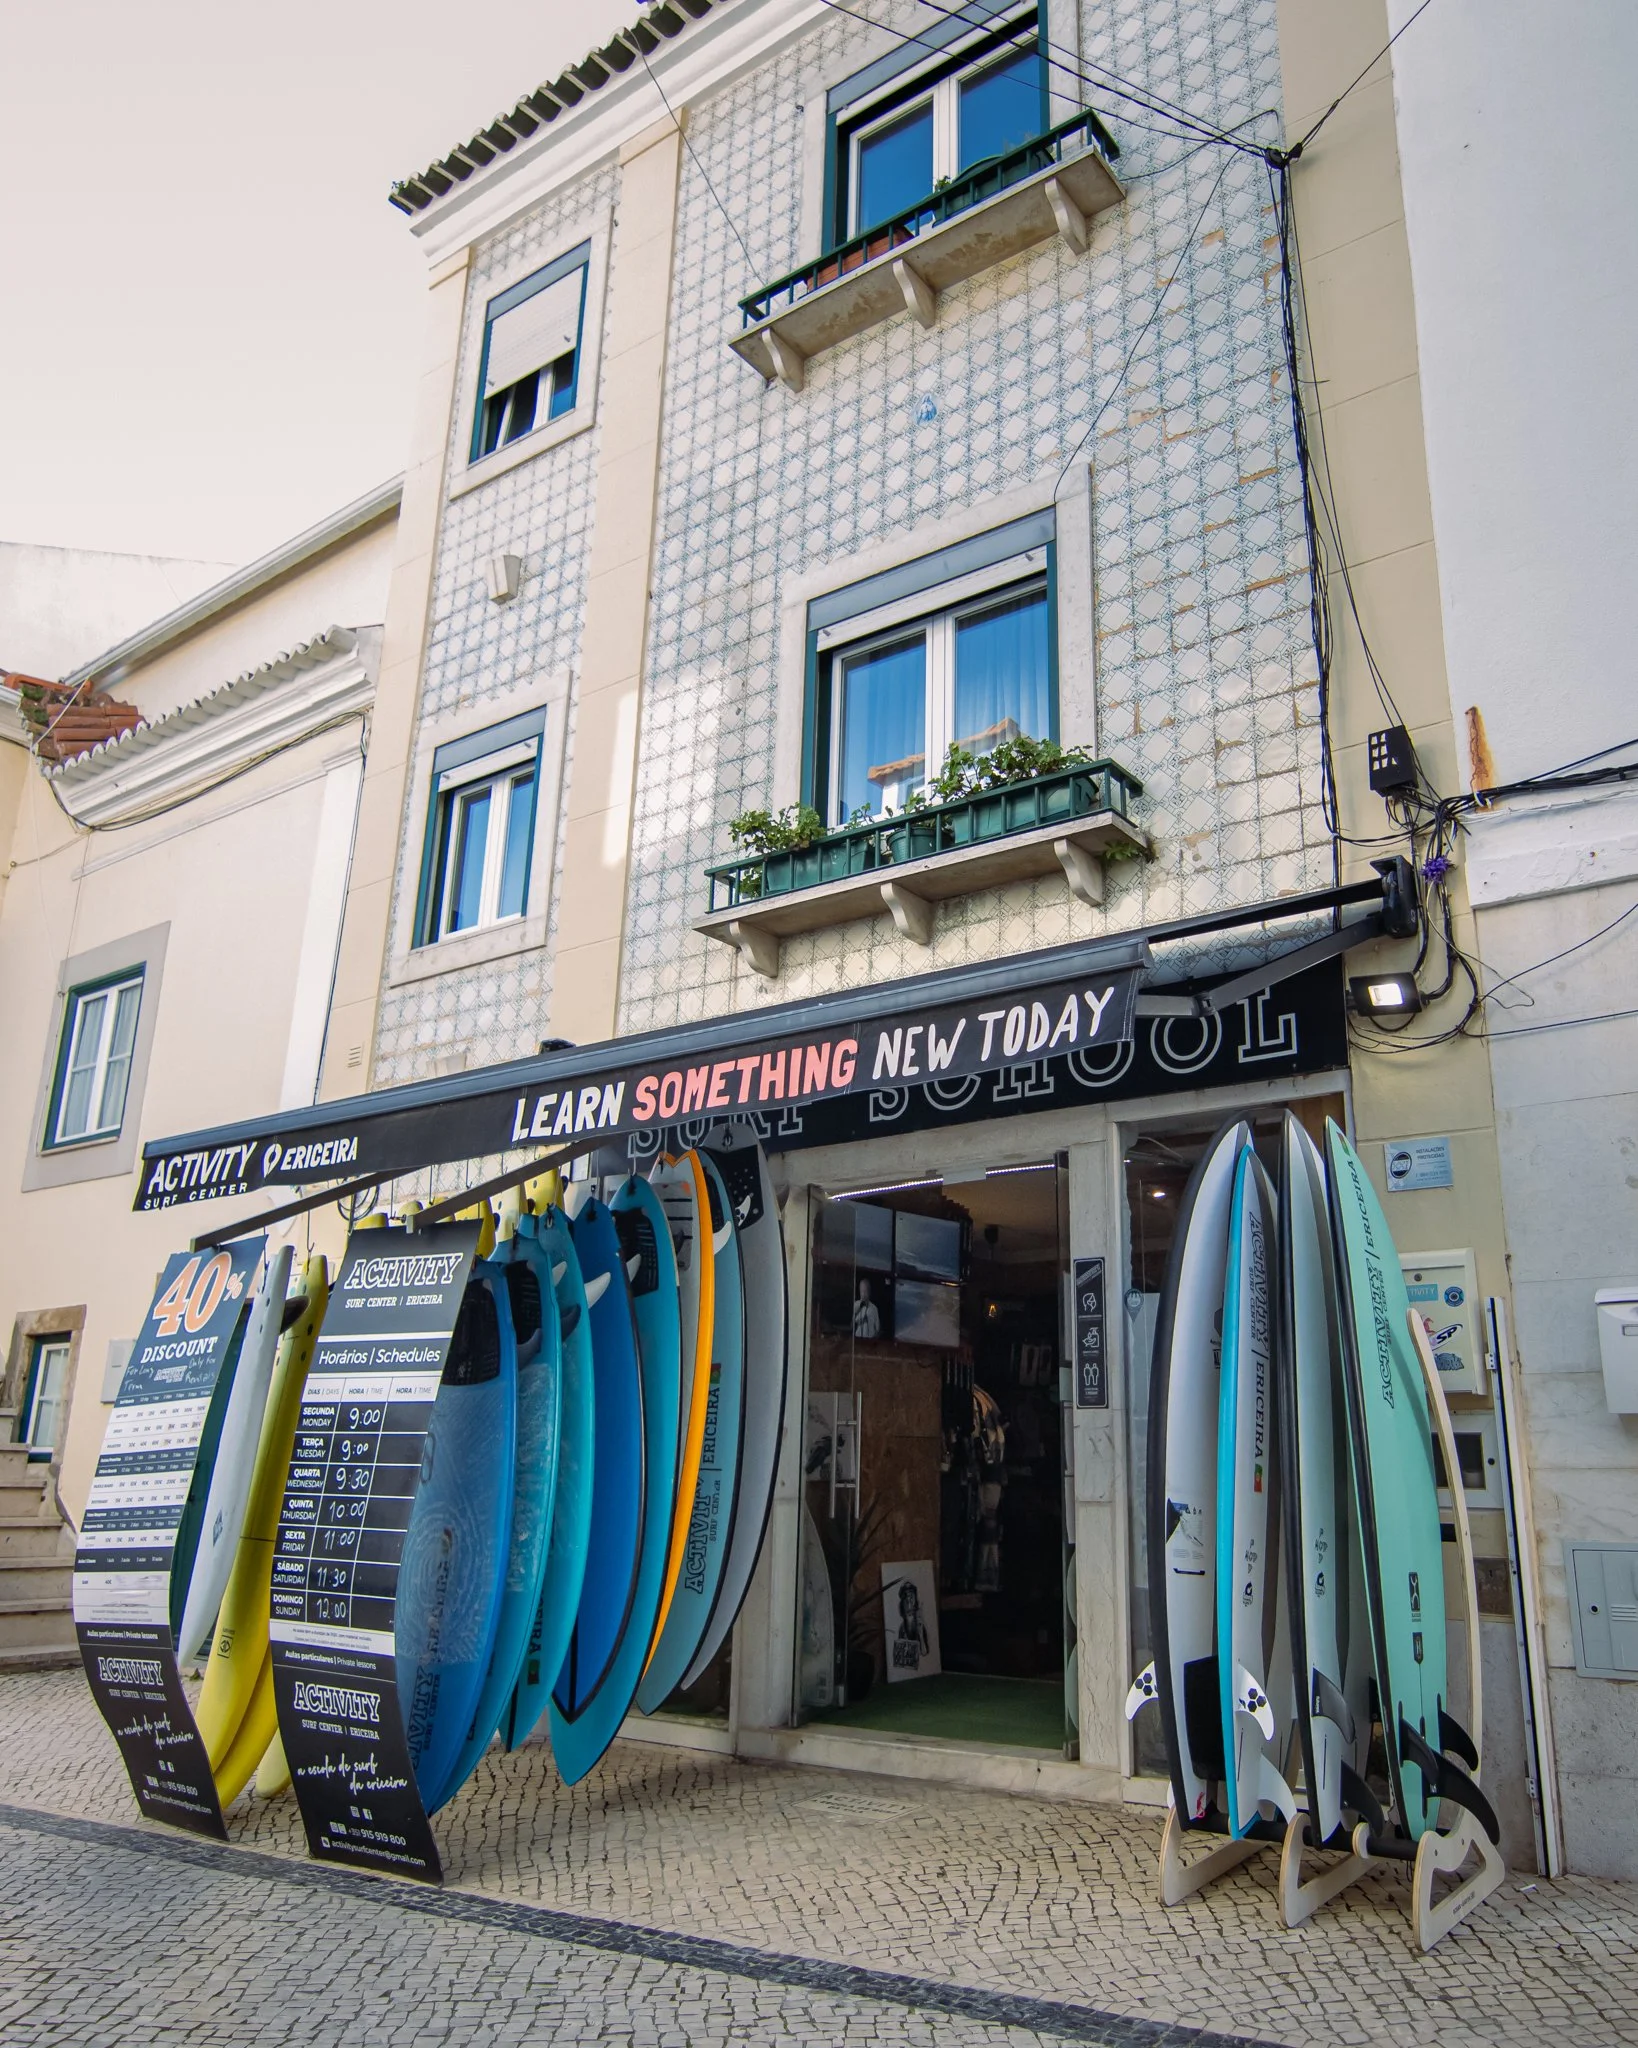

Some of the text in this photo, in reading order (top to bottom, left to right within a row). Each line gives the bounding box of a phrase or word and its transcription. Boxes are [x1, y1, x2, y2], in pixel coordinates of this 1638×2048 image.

[512, 1081, 626, 1142] LEARN
[632, 1039, 858, 1121] SOMETHING
[872, 1017, 966, 1080] NEW
[978, 986, 1115, 1062] TODAY
[147, 1136, 359, 1194] ACTIVITY ERICEIRA
[144, 1182, 248, 1210] SURF CENTER
[1347, 1160, 1374, 1248] ERICEIRA
[344, 1252, 464, 1289] ACTIVITY
[1249, 1211, 1269, 1352] ACTIVITY
[1379, 1270, 1388, 1312] CENTER
[152, 1251, 246, 1337] 40%
[345, 1298, 364, 1309] SURF
[367, 1296, 397, 1307] CENTER
[405, 1294, 443, 1306] ERICEIRA
[1366, 1258, 1394, 1409] ACTIVITY
[1436, 1326, 1458, 1344] SP
[140, 1336, 218, 1363] DISCOUNT
[319, 1349, 368, 1365] Horários
[376, 1347, 441, 1363] Schedules
[302, 1407, 335, 1416] SEGUNDA
[349, 1407, 381, 1429] 9:00
[1255, 1361, 1265, 1459] ERICEIRA
[302, 1418, 332, 1427] MONDAY
[302, 1438, 324, 1447] TERÇA
[342, 1439, 369, 1461] 9:00
[296, 1449, 326, 1458] TUESDAY
[287, 1479, 323, 1488] WEDNESDAY
[294, 1468, 320, 1478] QUARTA
[336, 1467, 370, 1490] 9:30
[289, 1499, 313, 1509] QUINTA
[329, 1500, 366, 1523] 10:00
[282, 1511, 316, 1520] THURSDAY
[284, 1530, 305, 1540] SEXTA
[324, 1530, 355, 1550] 11:00
[709, 1519, 719, 1542] SURF
[282, 1542, 305, 1551] FRIDAY
[277, 1561, 304, 1572] SÁBADO
[317, 1566, 346, 1588] 11:30
[273, 1574, 305, 1584] SATURDAY
[273, 1594, 304, 1605] DOMINGO
[317, 1598, 346, 1619] 12:00
[275, 1605, 301, 1616] SUNDAY
[285, 1650, 300, 1660] Aulas
[301, 1652, 334, 1664] particulares
[337, 1657, 356, 1667] Private
[356, 1659, 376, 1670] lessons
[98, 1657, 164, 1686] ACTIVITY
[294, 1681, 380, 1722] ACTIVITY
[301, 1719, 317, 1729] SURF
[319, 1722, 343, 1734] CENTER
[350, 1727, 380, 1740] ERICEIRA
[297, 1752, 378, 1779] a escola de surf
[350, 1771, 408, 1796] da ericeira
[361, 1828, 374, 1839] 915
[376, 1830, 389, 1842] 919
[390, 1834, 406, 1846] 800
[331, 1840, 426, 1867] activitysurfcenter@gmail.com
